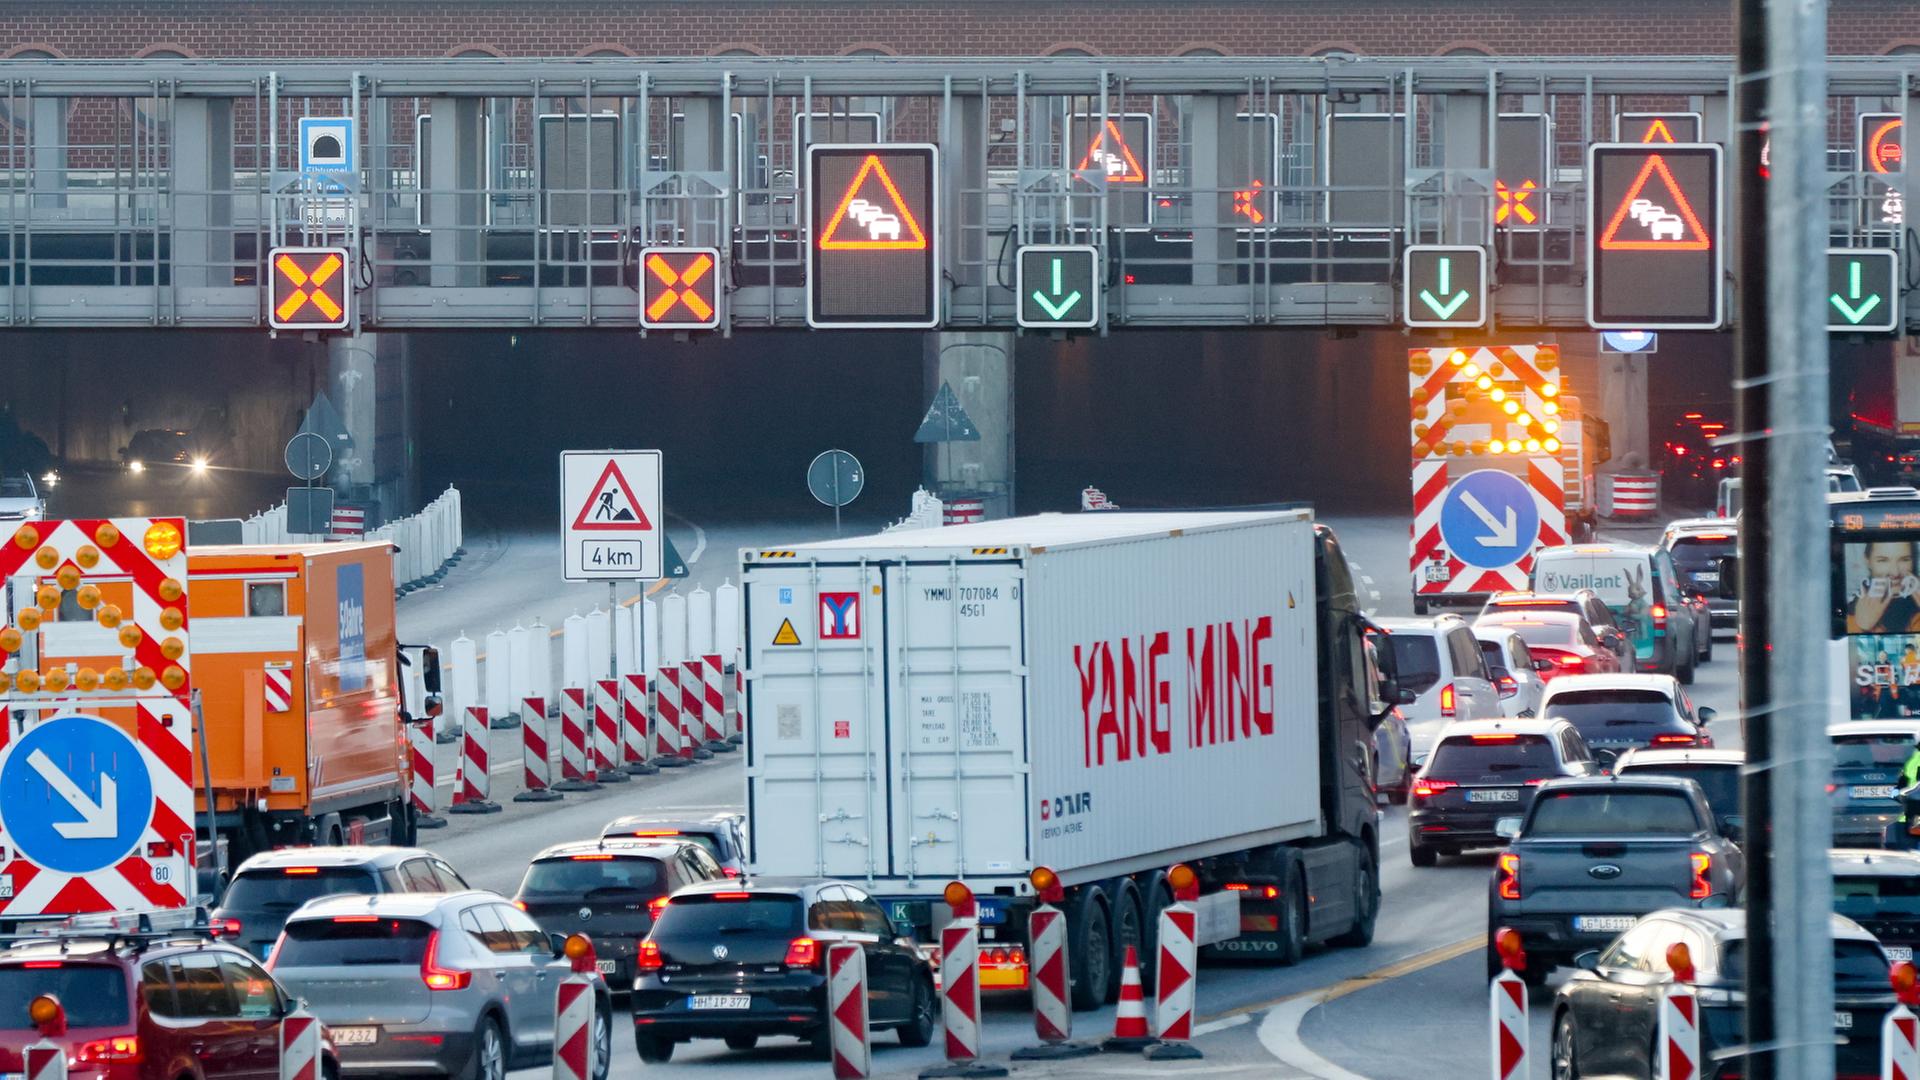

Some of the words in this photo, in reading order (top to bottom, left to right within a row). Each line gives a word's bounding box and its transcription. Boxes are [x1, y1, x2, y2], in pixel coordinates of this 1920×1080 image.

[592, 547, 602, 565] 4
[607, 547, 633, 565] km
[1560, 574, 1622, 589] Vaillant
[924, 588, 952, 601] YMMU
[960, 587, 999, 600] 707084
[1012, 586, 1018, 600] 0
[960, 604, 985, 617] 45G1
[1073, 631, 1171, 768] YANG
[1186, 616, 1274, 749] MING
[155, 866, 169, 880] 80
[895, 905, 907, 918] K
[1581, 919, 1593, 928] LG
[1600, 919, 1611, 928] LG
[1215, 941, 1279, 952] VOLVO
[1887, 949, 1912, 959] 3750
[694, 997, 708, 1006] HH
[714, 998, 727, 1007] IP
[730, 998, 749, 1007] 377
